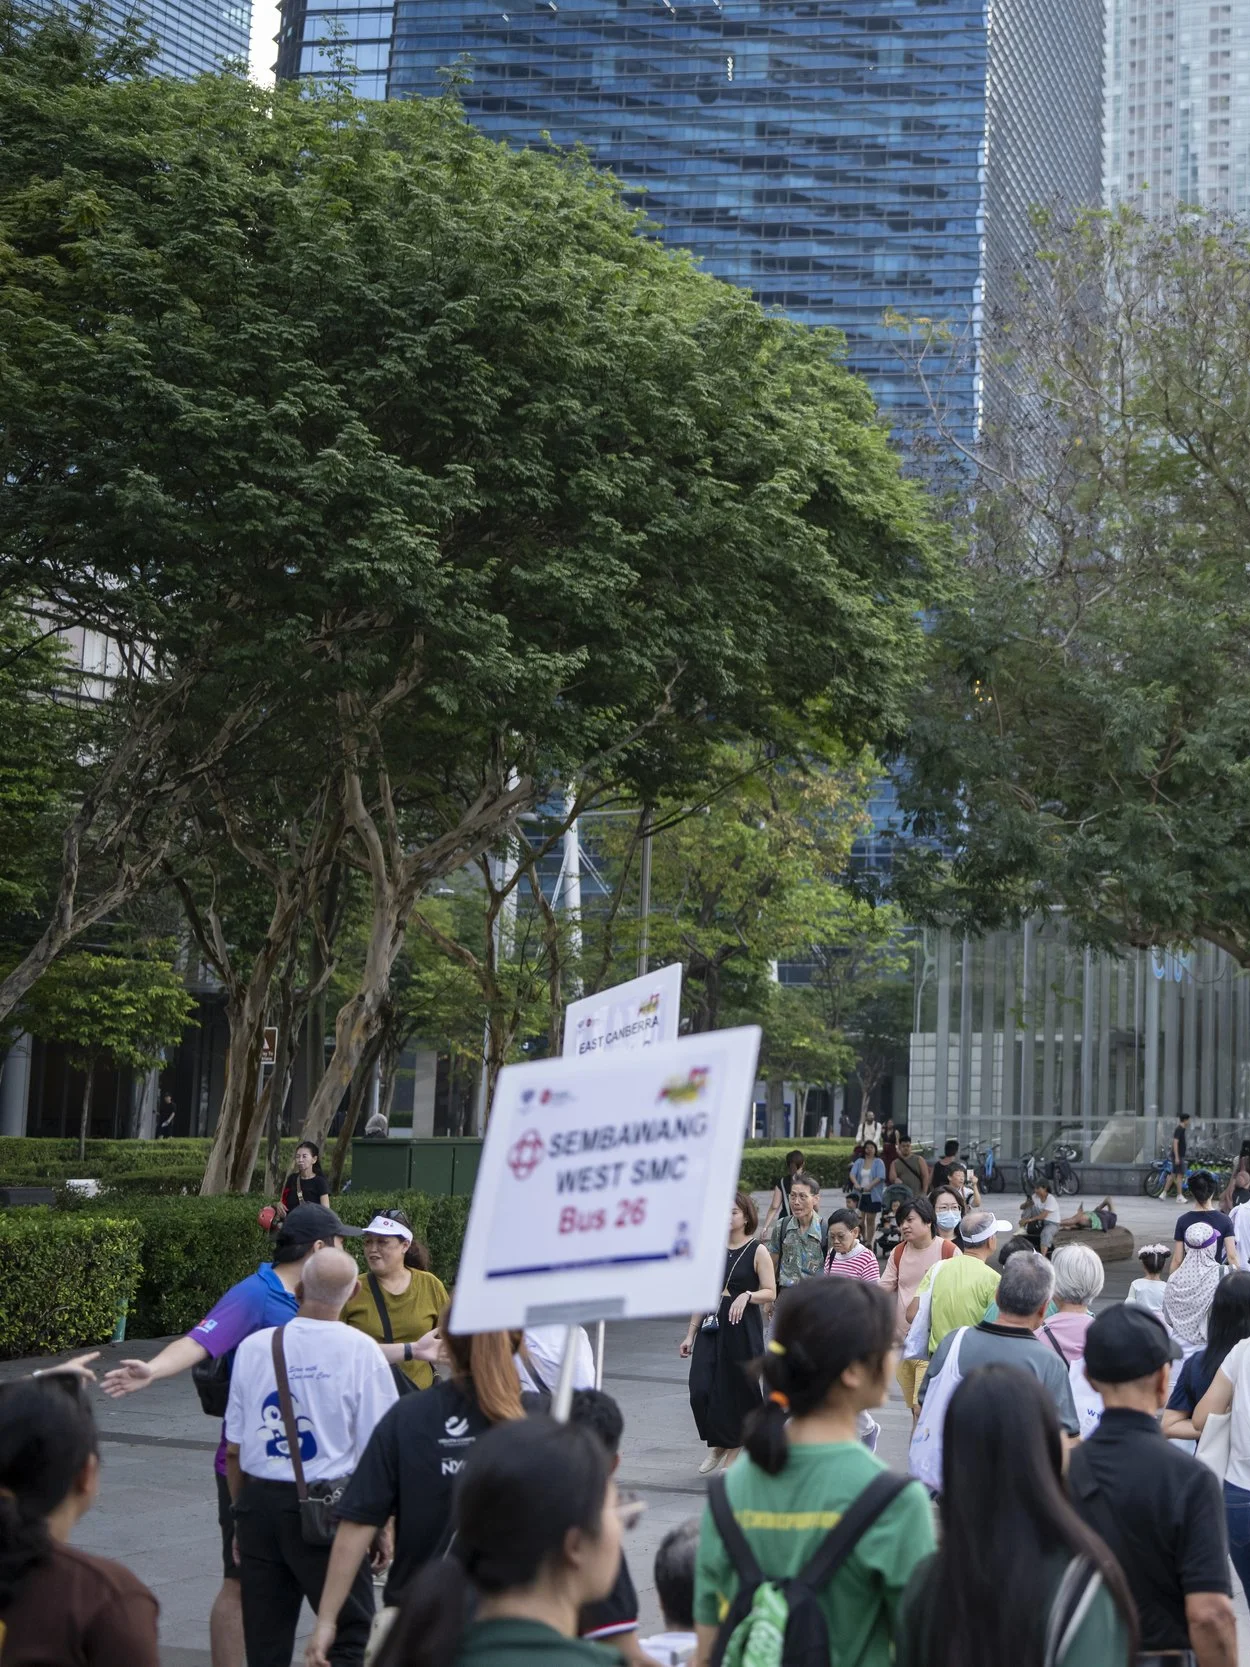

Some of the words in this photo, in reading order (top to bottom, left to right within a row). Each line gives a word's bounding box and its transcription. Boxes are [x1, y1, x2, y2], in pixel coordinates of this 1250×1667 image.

[578, 1035, 604, 1055] EAST
[605, 1015, 660, 1045] CANBERRA
[548, 1112, 709, 1159] SEMBAWANG
[556, 1161, 625, 1194] WEST
[630, 1154, 688, 1186] SMC
[557, 1205, 607, 1235] Bus
[614, 1197, 648, 1229] 26
[1087, 1409, 1101, 1420] WT
[442, 1459, 467, 1476] NY
